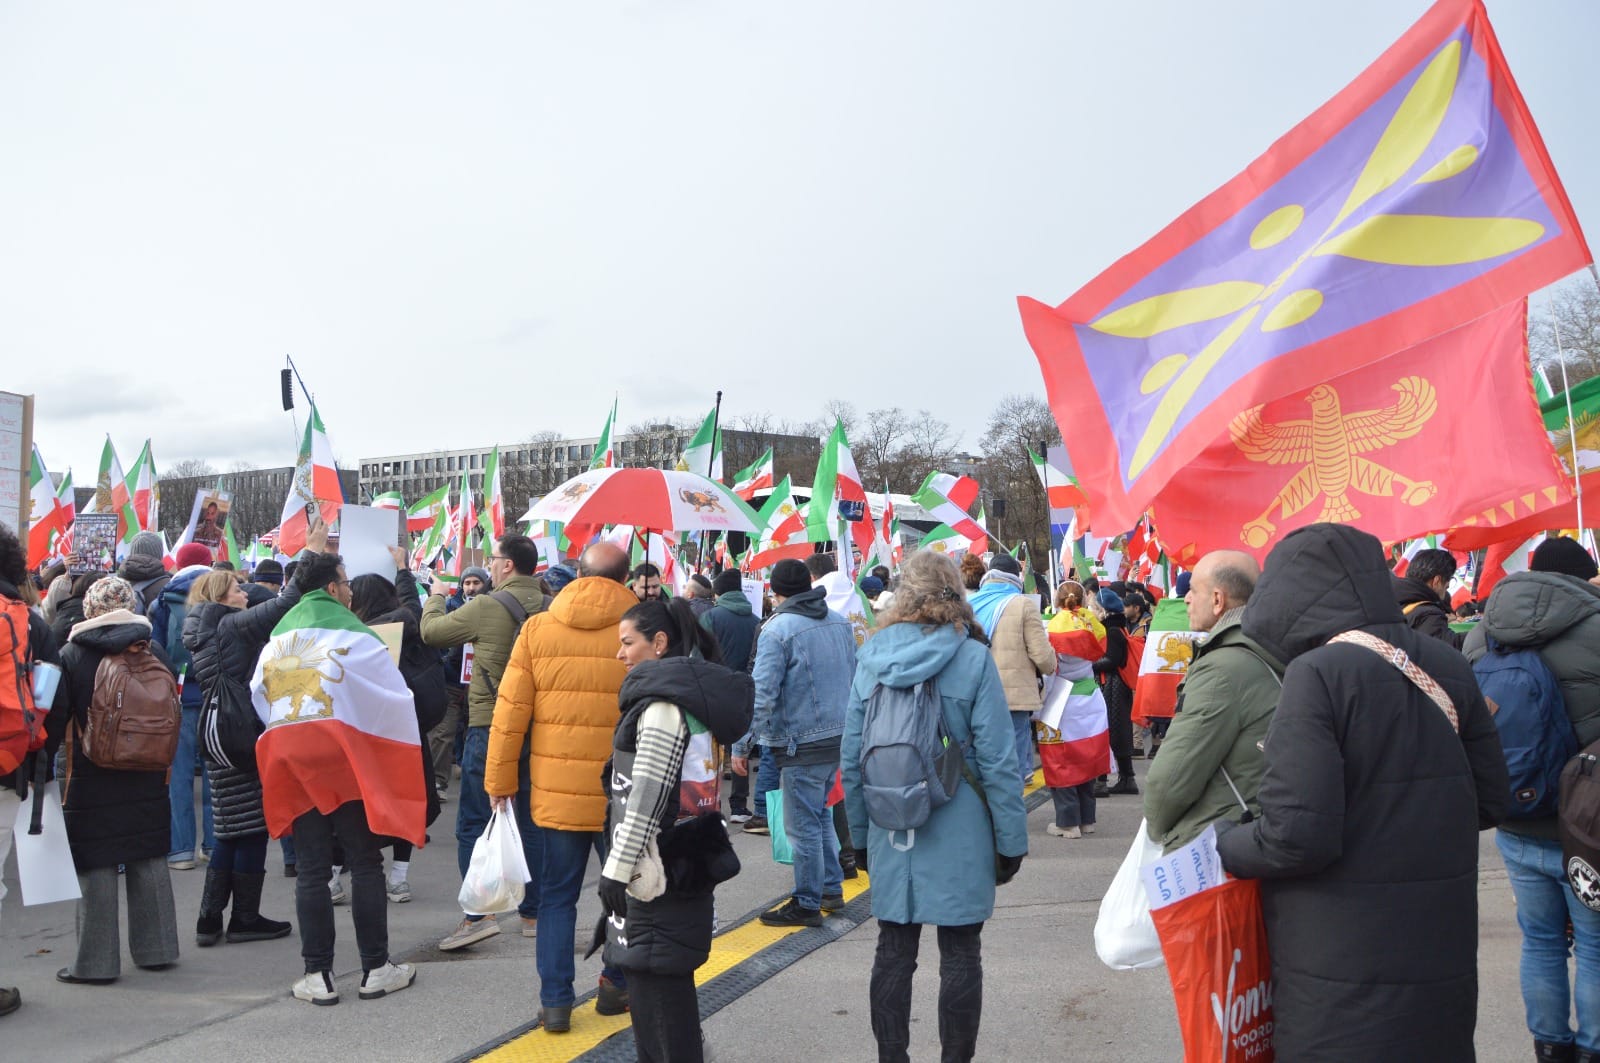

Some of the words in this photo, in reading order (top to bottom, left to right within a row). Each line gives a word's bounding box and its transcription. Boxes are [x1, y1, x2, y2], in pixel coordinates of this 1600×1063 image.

[696, 797, 713, 807] ALL
[1232, 1021, 1273, 1049] VOORD
[1245, 1037, 1274, 1061] MAR
